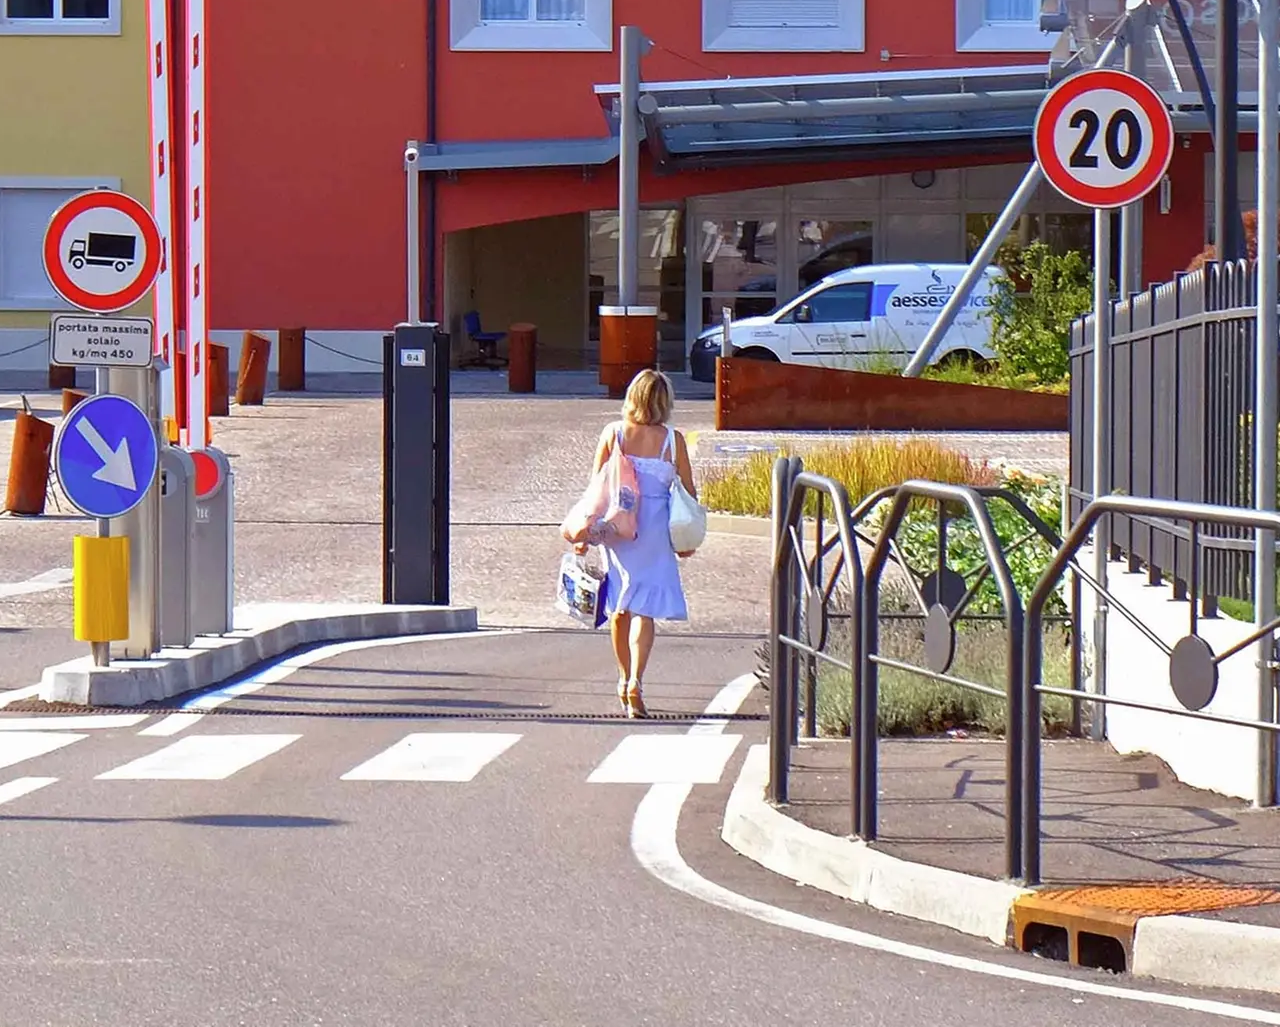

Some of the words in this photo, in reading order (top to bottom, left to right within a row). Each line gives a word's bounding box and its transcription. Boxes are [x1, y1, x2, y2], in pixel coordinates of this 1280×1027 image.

[1069, 108, 1143, 170] 20
[58, 323, 99, 333] portata
[102, 325, 149, 335] massima
[87, 337, 121, 346] solaio
[72, 348, 108, 359] kg/mq
[110, 350, 134, 359] 450
